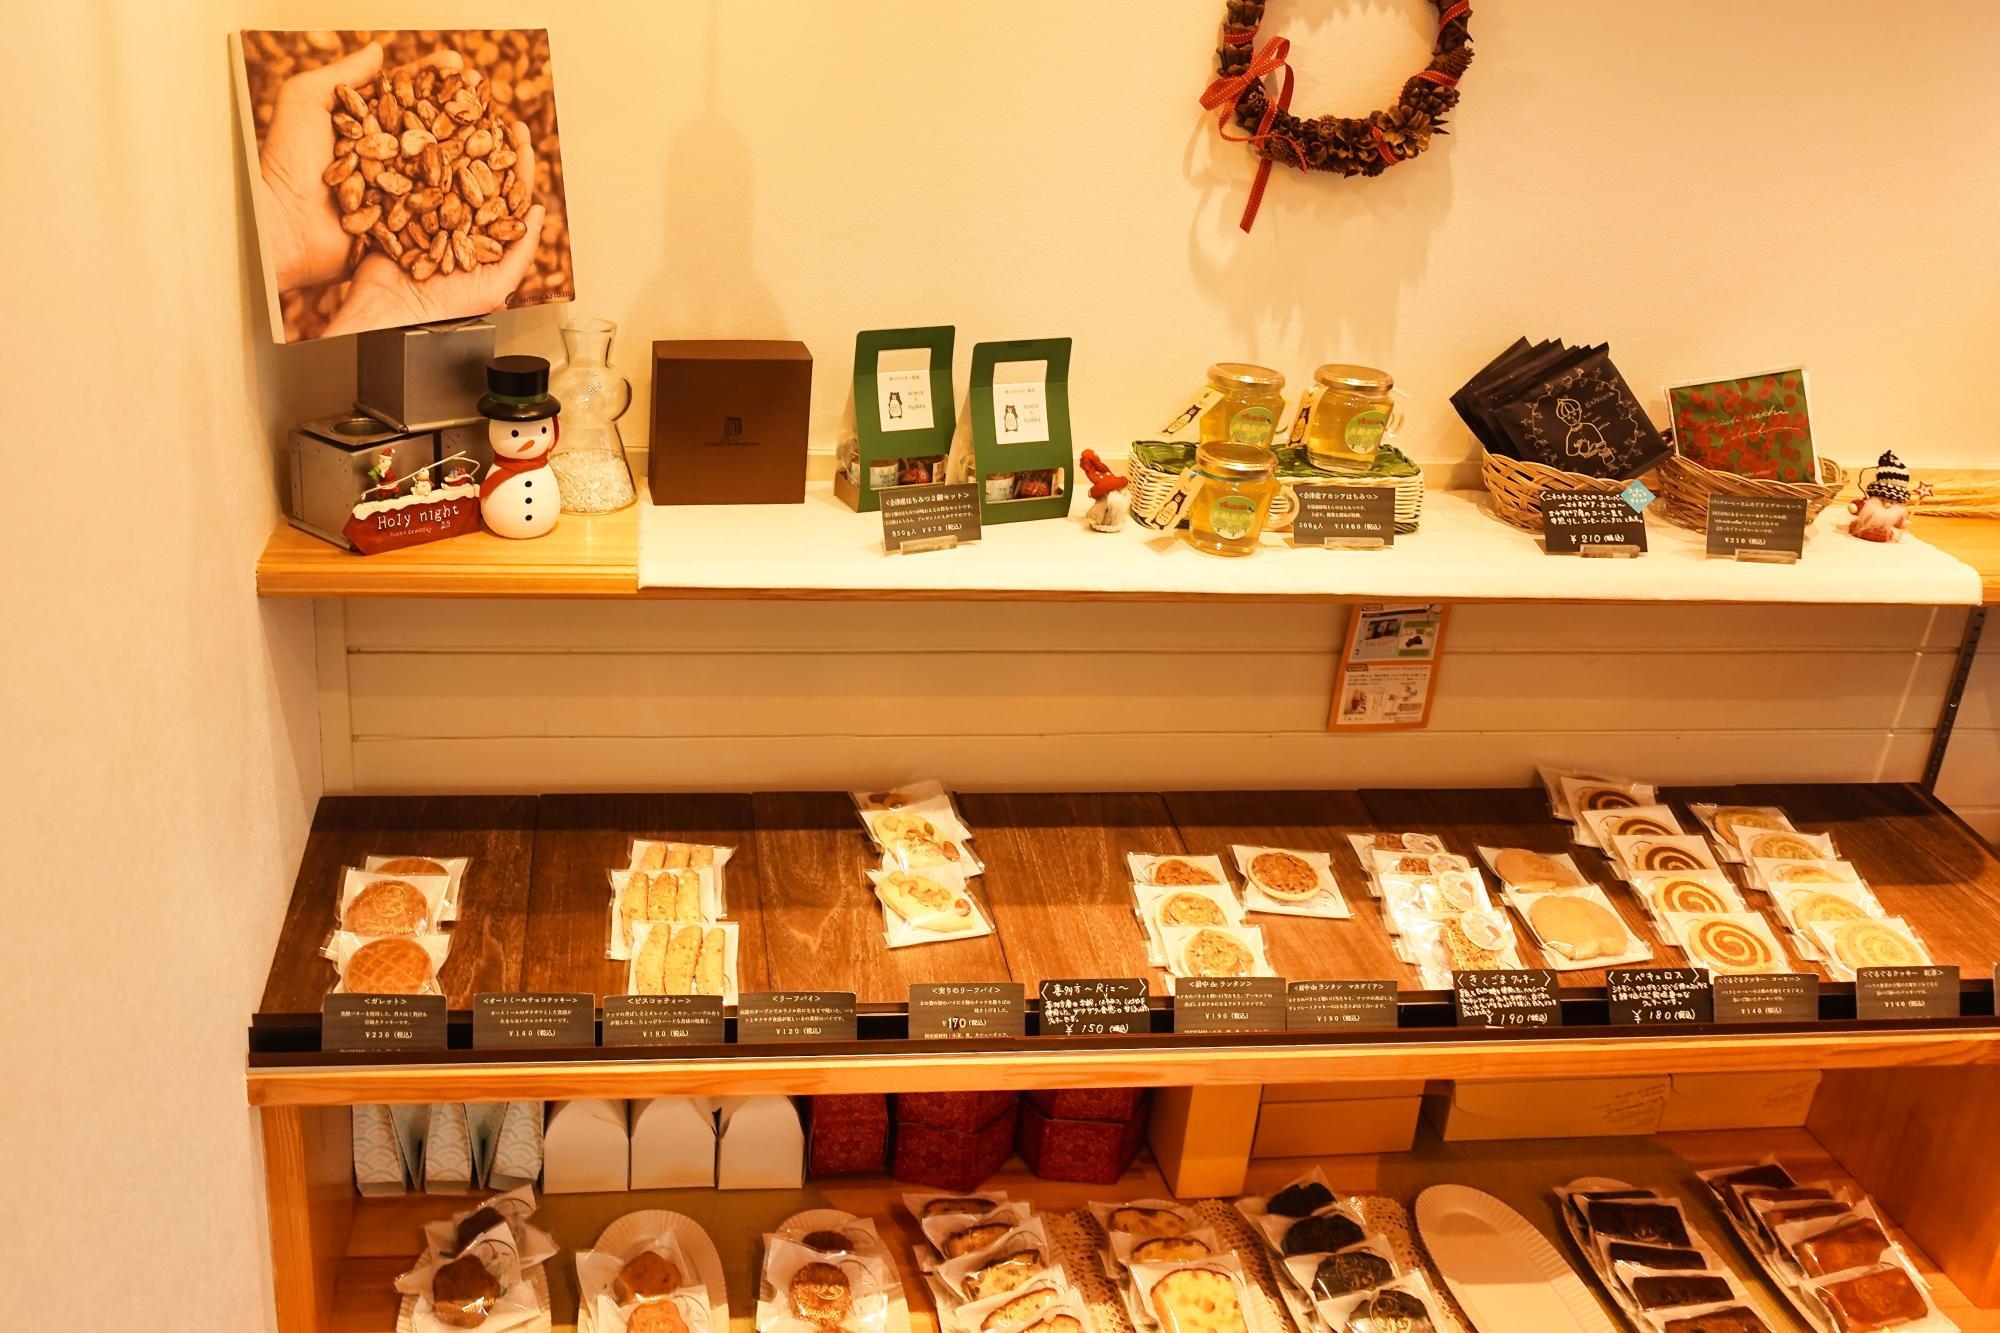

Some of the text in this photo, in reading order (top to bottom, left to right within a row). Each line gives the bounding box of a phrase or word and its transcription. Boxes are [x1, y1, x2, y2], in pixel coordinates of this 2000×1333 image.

[378, 504, 459, 529] Holy night
[932, 986, 1001, 995] <実りのリーフパイ>
[483, 996, 578, 1005] <オートミールチョコクッキー>
[627, 997, 692, 1005] <ビスコッティー>
[772, 994, 821, 1002] <リーフパイ>
